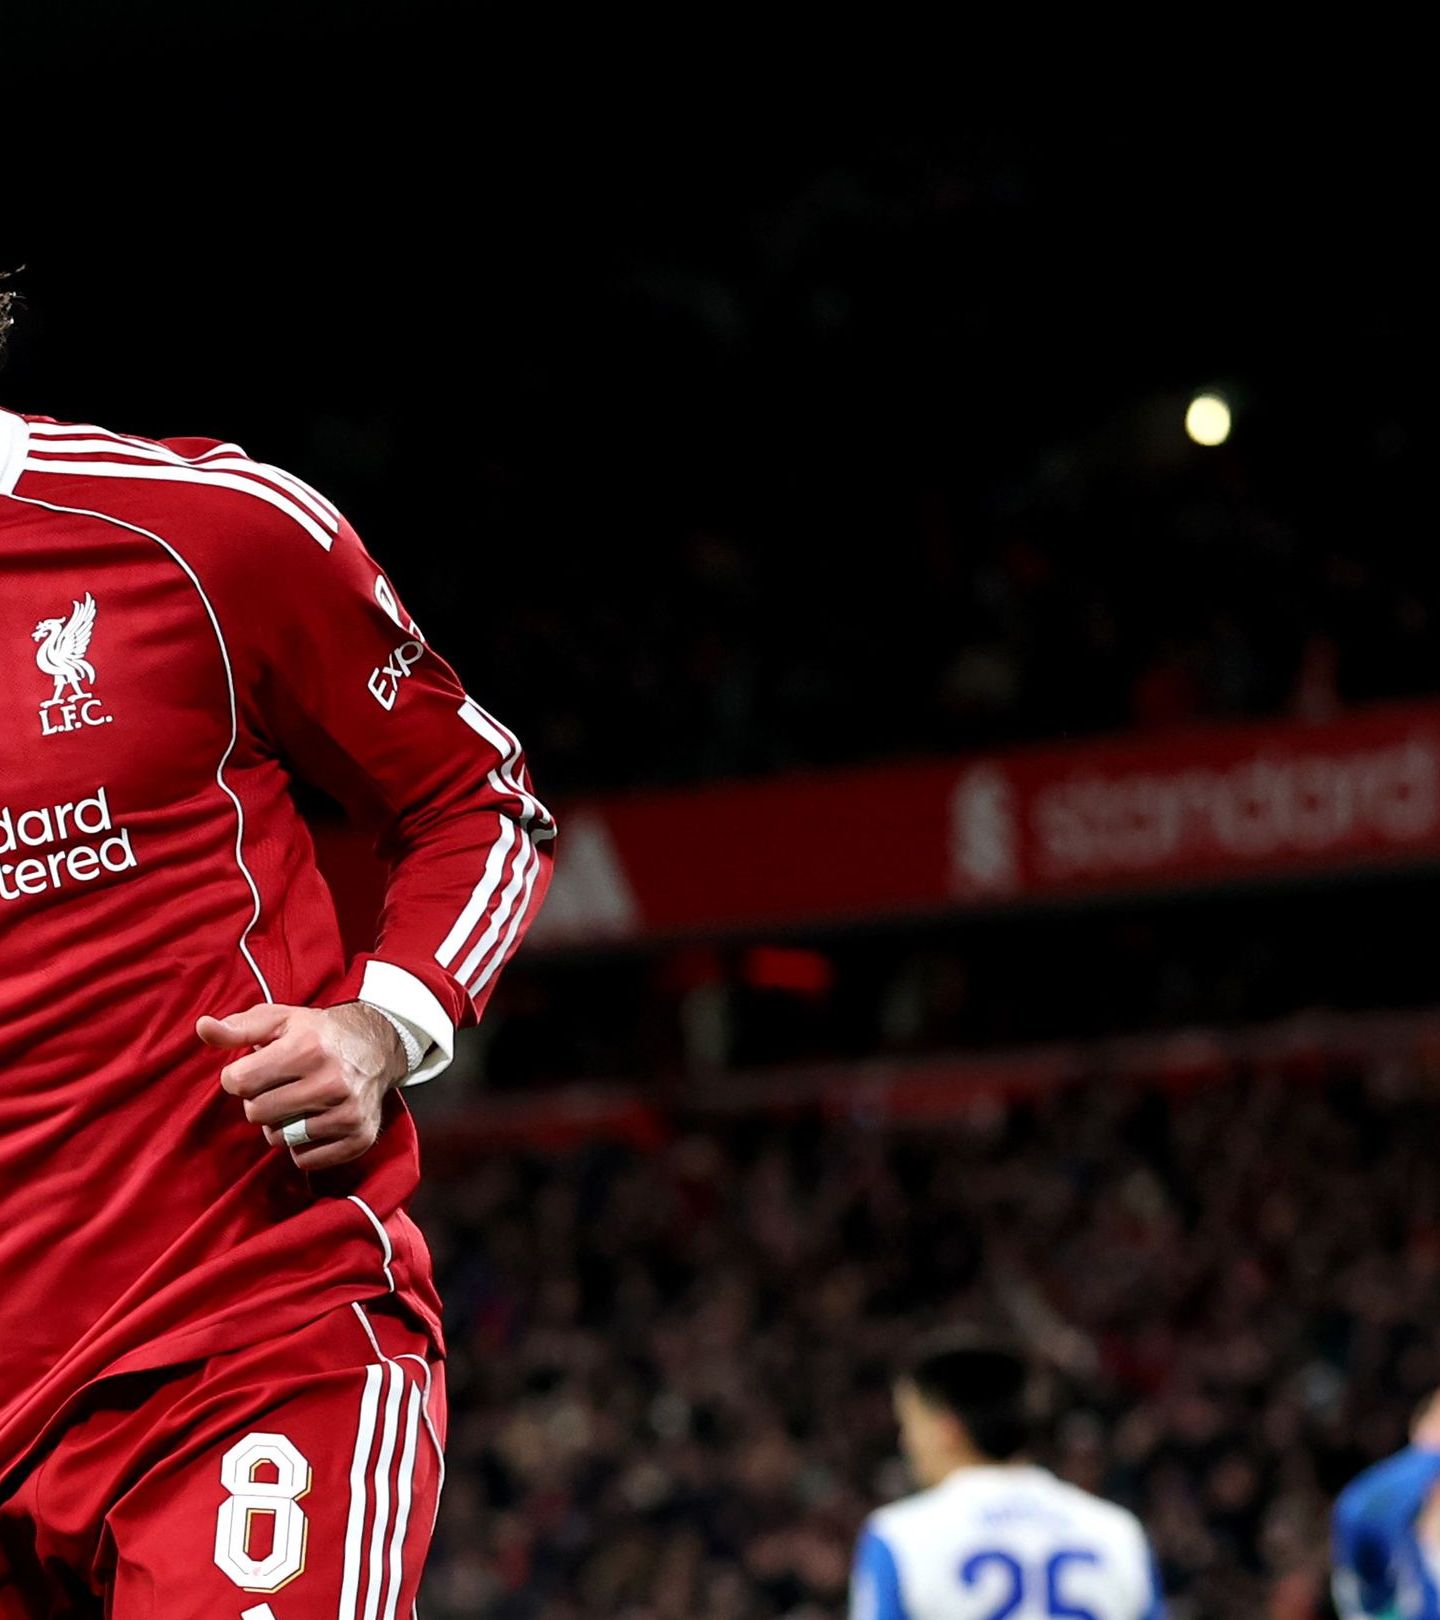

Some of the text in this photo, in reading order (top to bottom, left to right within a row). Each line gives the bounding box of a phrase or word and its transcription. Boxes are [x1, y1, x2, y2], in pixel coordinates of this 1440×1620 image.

[38, 699, 113, 736] L.F.C.
[213, 1431, 312, 1594] 8
[959, 1547, 1107, 1620] 25
